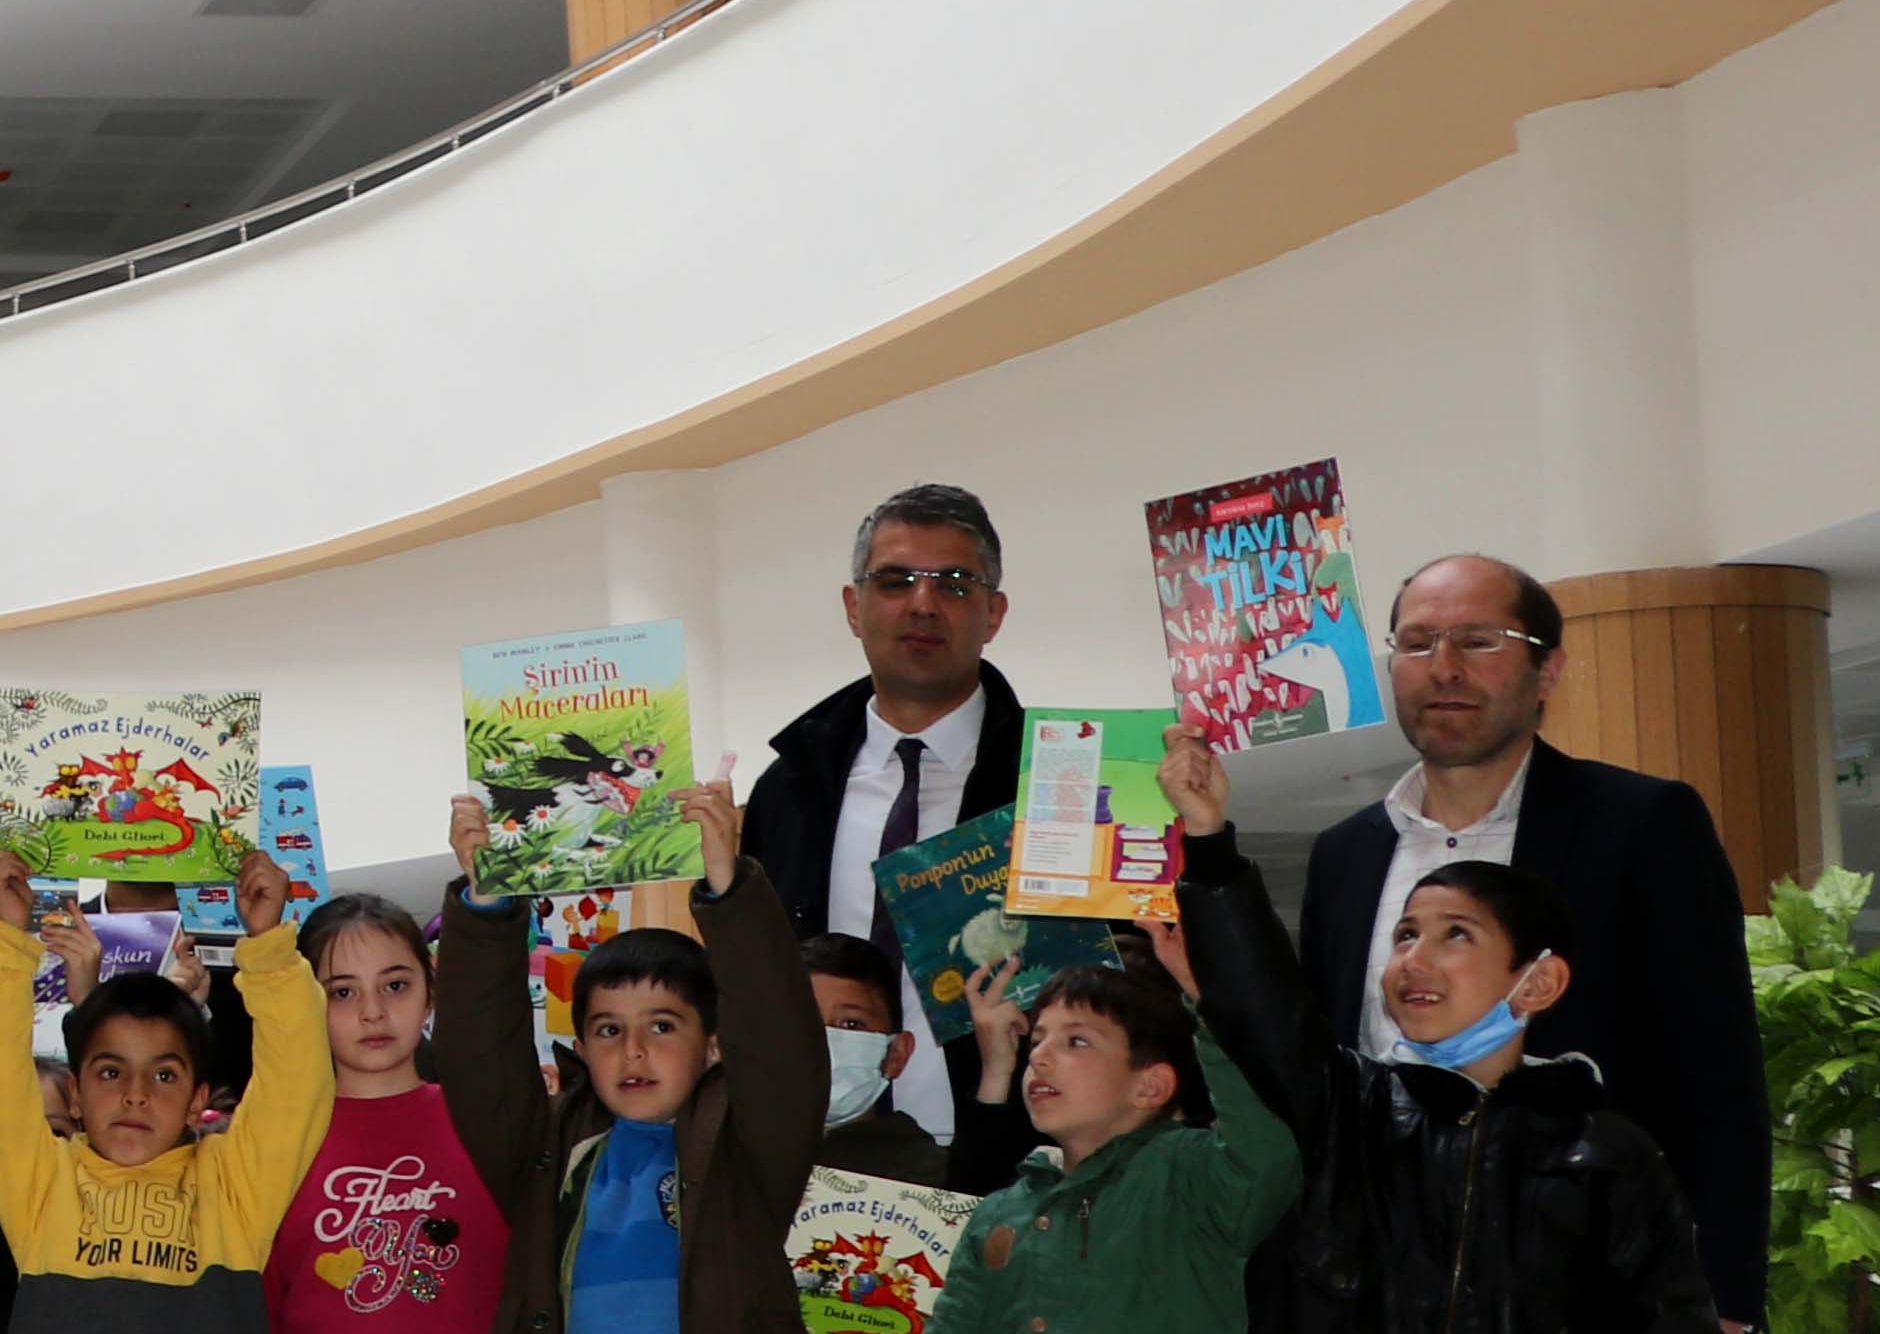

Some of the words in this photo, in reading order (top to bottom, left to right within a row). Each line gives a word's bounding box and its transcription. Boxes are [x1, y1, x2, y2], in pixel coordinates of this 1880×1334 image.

[1200, 550, 1306, 611] TİLKİ
[523, 656, 619, 696] Şirin'in
[499, 685, 650, 722] Maceraları
[24, 719, 110, 758] Yaramaz
[115, 717, 210, 761] Ejderhalar
[101, 945, 152, 964] skun
[314, 1155, 456, 1242] Heart
[870, 1200, 951, 1258] Ejderhalar
[131, 1240, 198, 1272] LIMITS
